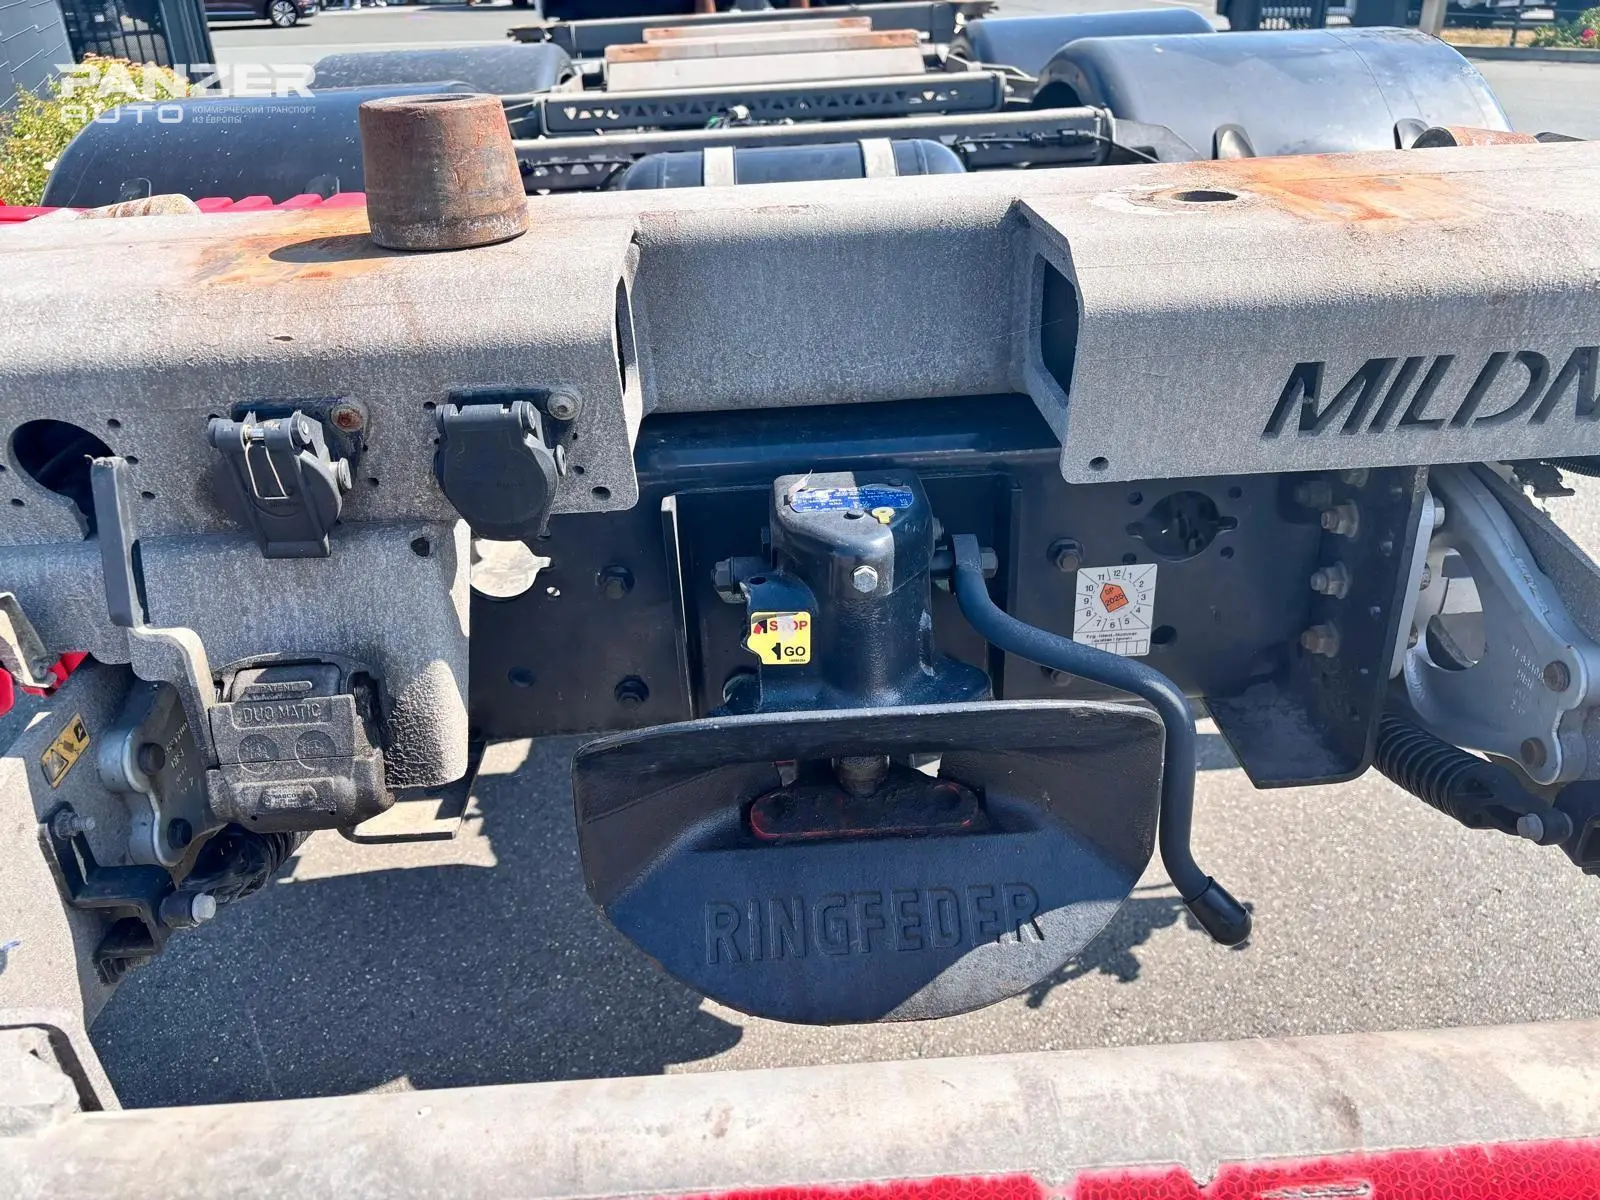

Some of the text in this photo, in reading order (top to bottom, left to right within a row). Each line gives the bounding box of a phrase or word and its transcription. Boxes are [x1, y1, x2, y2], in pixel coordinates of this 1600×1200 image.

[1139, 580, 1144, 588] 2
[1105, 592, 1124, 607] 2025
[769, 620, 808, 631] SP
[1096, 619, 1101, 627] 7
[784, 646, 806, 657] GO
[242, 703, 321, 724] DUO MATIC
[704, 882, 1045, 966] RINGFEDER
